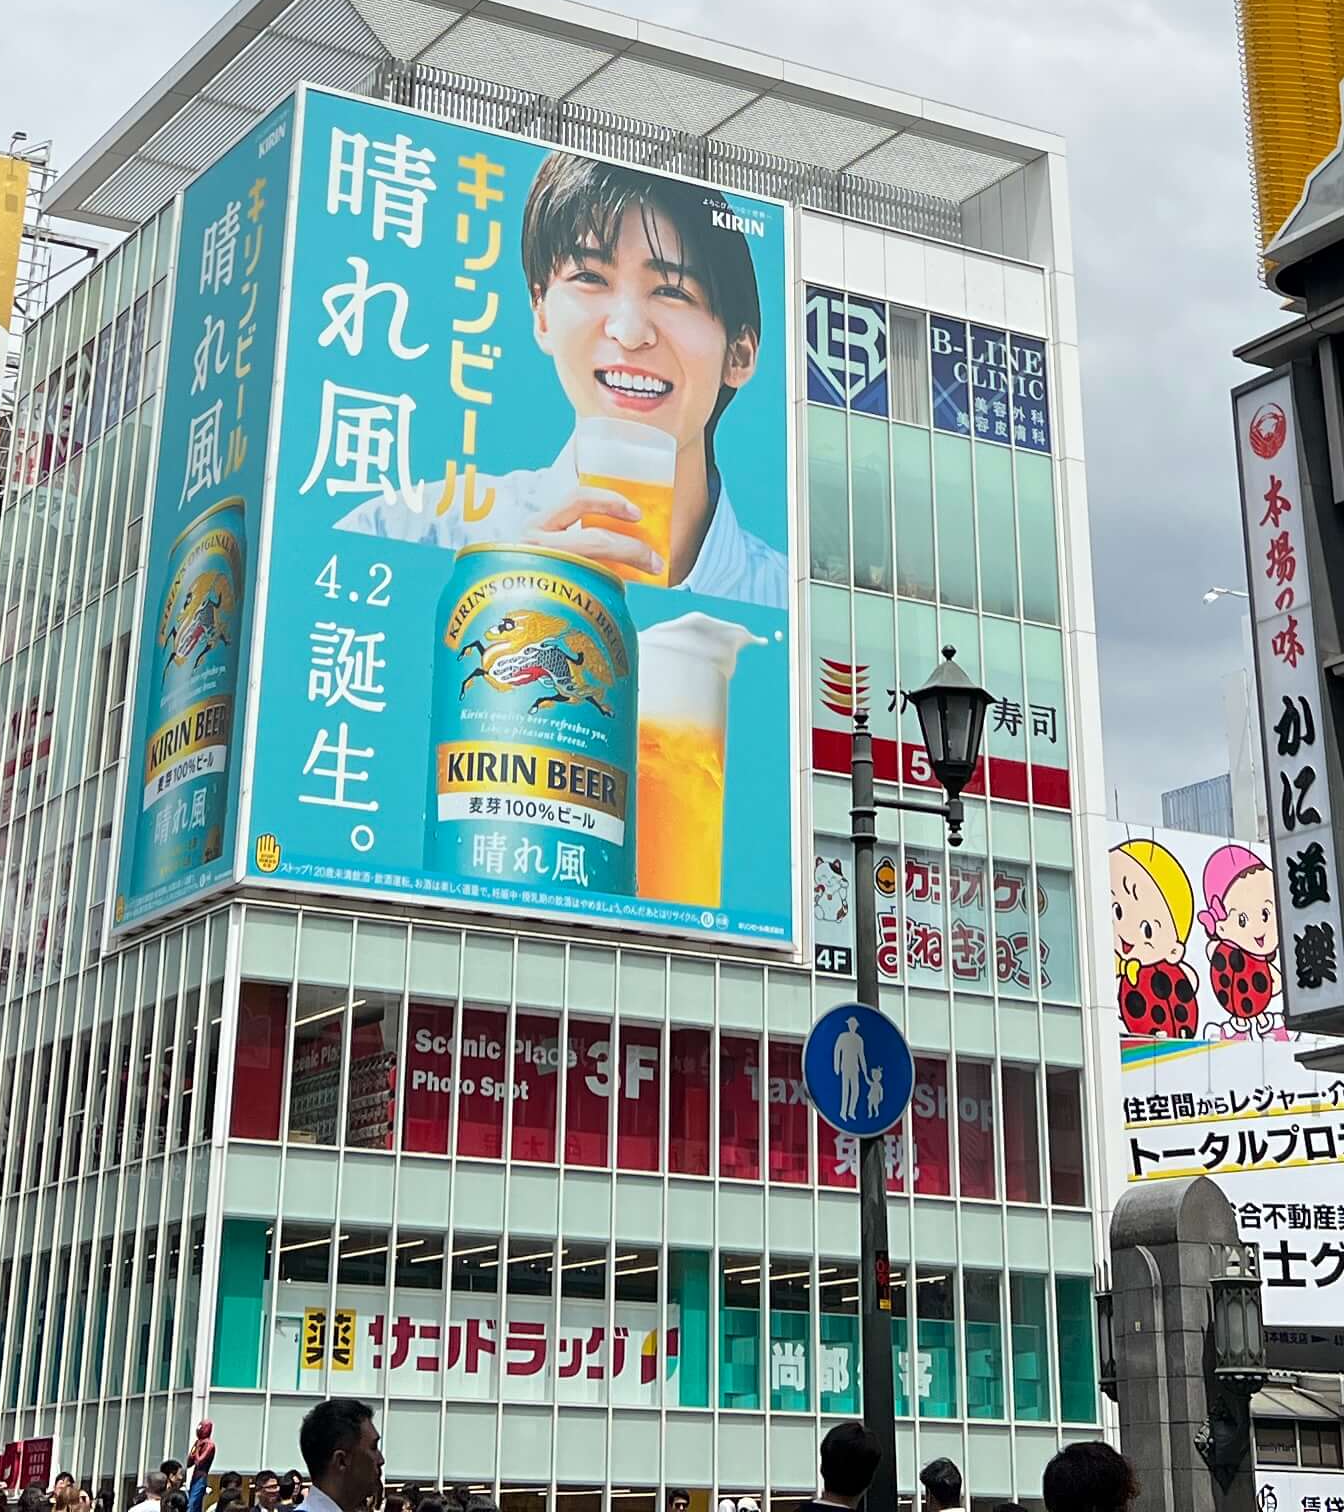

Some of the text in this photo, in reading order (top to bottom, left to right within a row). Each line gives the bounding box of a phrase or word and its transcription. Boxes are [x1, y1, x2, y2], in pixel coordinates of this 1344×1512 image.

[258, 122, 287, 160] KIRIN
[711, 209, 765, 238] KIRIN
[224, 175, 267, 481] キリンビール
[299, 125, 438, 513] 晴れ風
[437, 151, 504, 524] キリンビール
[178, 201, 242, 512] 晴れ風
[931, 327, 1044, 377] B-LINE
[954, 361, 1045, 401] CLINIC
[956, 411, 1046, 446] 美容皮膚科
[975, 396, 1044, 427] 美容外科
[315, 554, 392, 606] 4.2
[1260, 473, 1305, 670] 本場の味
[449, 575, 627, 666] KIRIN'S ORIGINAL BREW
[150, 701, 227, 771] KIRIN BEER
[446, 750, 617, 804] KIRIN BEER
[153, 788, 207, 845] 晴れ風
[468, 796, 596, 830] 麦芽100%ビール
[471, 831, 589, 888] 晴れ風
[901, 859, 1025, 914] カラオケ
[816, 947, 848, 972] 4F
[877, 917, 1052, 990] まねきねこ
[414, 1028, 578, 1068] Scenic Place
[584, 1041, 658, 1100] 3F
[744, 1065, 807, 1105] Tax
[833, 1132, 920, 1180] 免税
[304, 1311, 353, 1367] 薬
[369, 1314, 627, 1383] サンドラッグ
